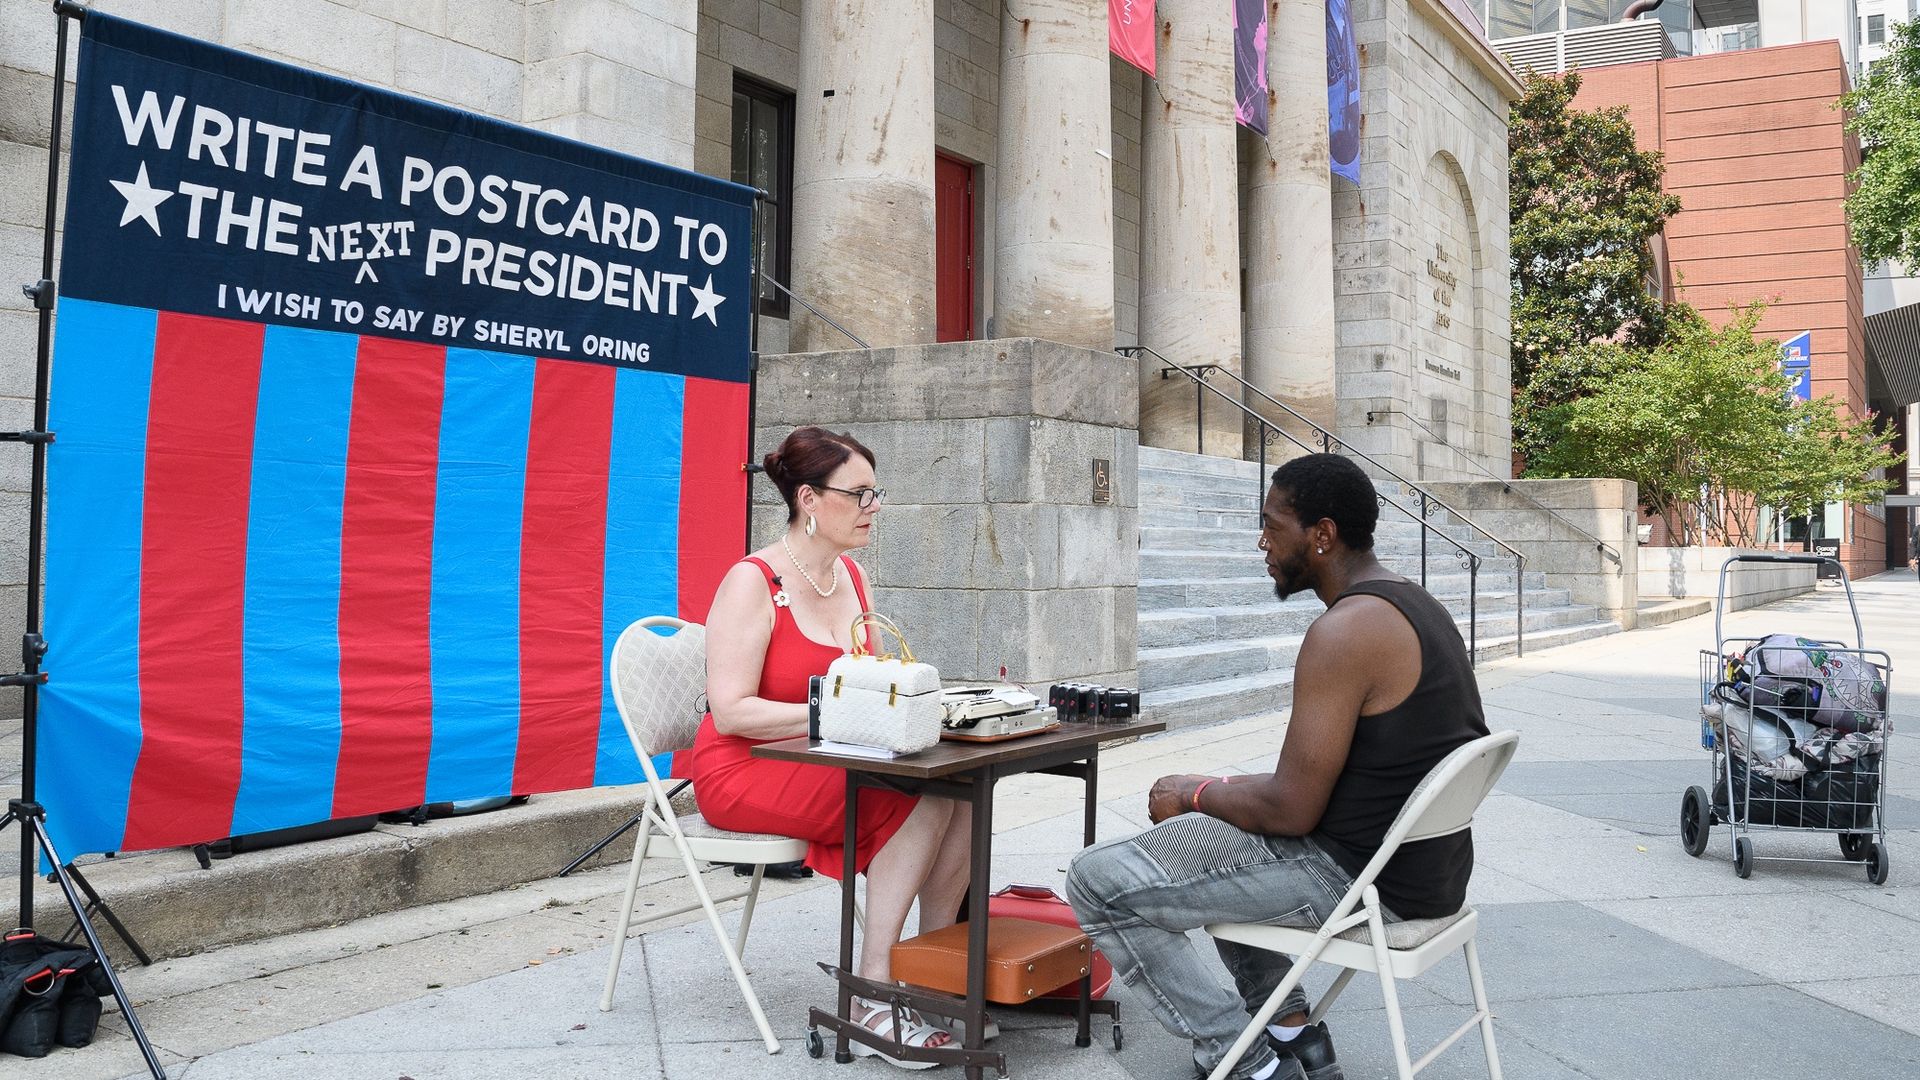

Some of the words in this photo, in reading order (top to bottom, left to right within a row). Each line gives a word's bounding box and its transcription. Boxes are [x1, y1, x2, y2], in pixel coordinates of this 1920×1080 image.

[111, 84, 331, 186] WRITE
[339, 144, 383, 200] A
[400, 155, 661, 252] POSTCARD
[673, 215, 728, 266] TO
[178, 180, 303, 256] THE
[307, 220, 415, 263] NEXT
[425, 228, 689, 316] PRESIDENT
[218, 283, 227, 309] I
[235, 286, 321, 323] WISH
[330, 298, 364, 325] TO
[372, 305, 425, 332] SAY
[431, 313, 466, 338] BY
[473, 319, 571, 353] SHERYL
[582, 334, 650, 363] ORING
